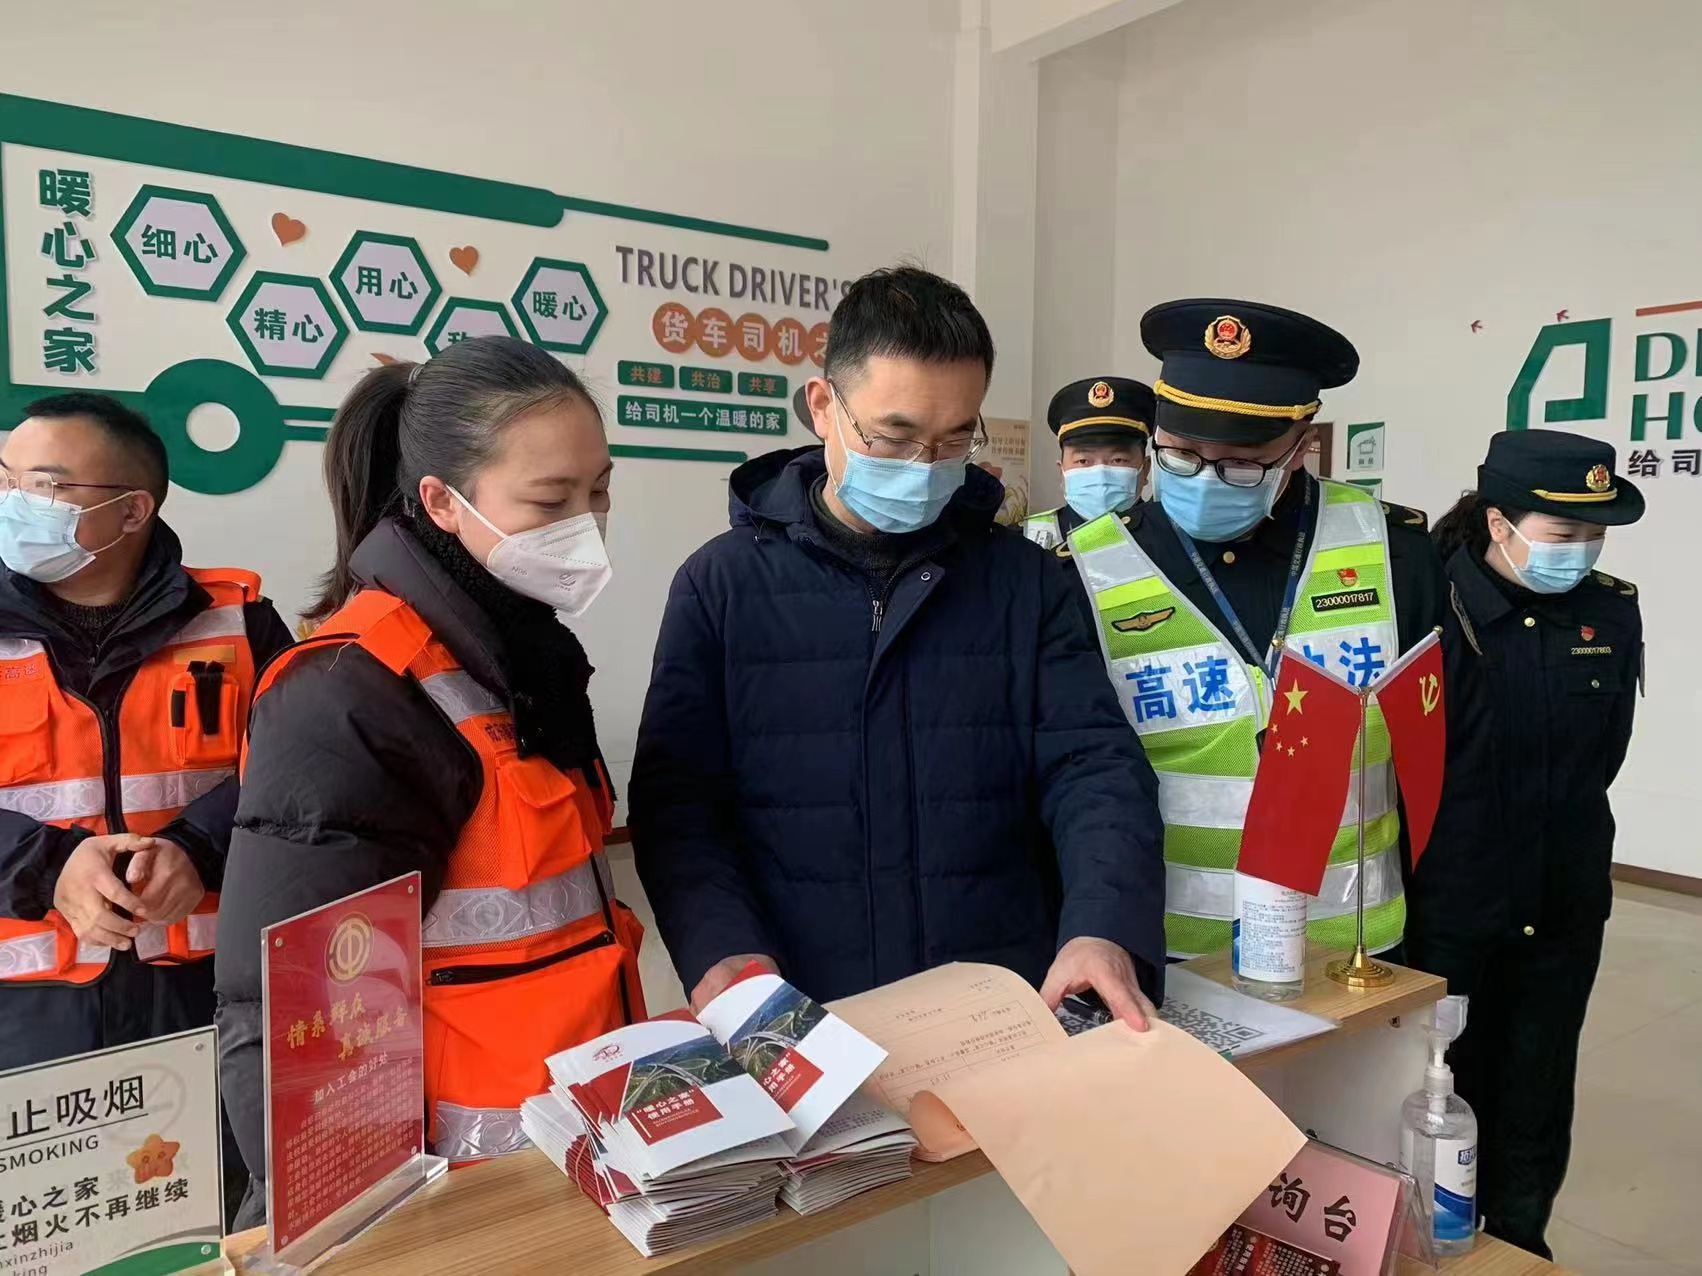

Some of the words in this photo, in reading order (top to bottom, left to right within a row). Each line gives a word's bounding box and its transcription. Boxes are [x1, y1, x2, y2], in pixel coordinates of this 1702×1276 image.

[141, 224, 220, 265] 细心
[38, 167, 96, 376] 暖心之家
[355, 265, 419, 300] 用心
[615, 245, 722, 297] TRUCK
[532, 290, 588, 322] 暖心
[253, 307, 325, 344] 精心
[630, 365, 664, 385] 共建
[691, 370, 721, 390] 共治
[749, 377, 776, 395] 共享
[625, 401, 781, 430] 给司机一个温暖的家
[1314, 591, 1374, 609] 23000017817
[1125, 655, 1236, 724] 高速
[6, 1075, 144, 1141] 止吸烟
[0, 1176, 100, 1223] 心之家
[1268, 1172, 1357, 1243] 询台
